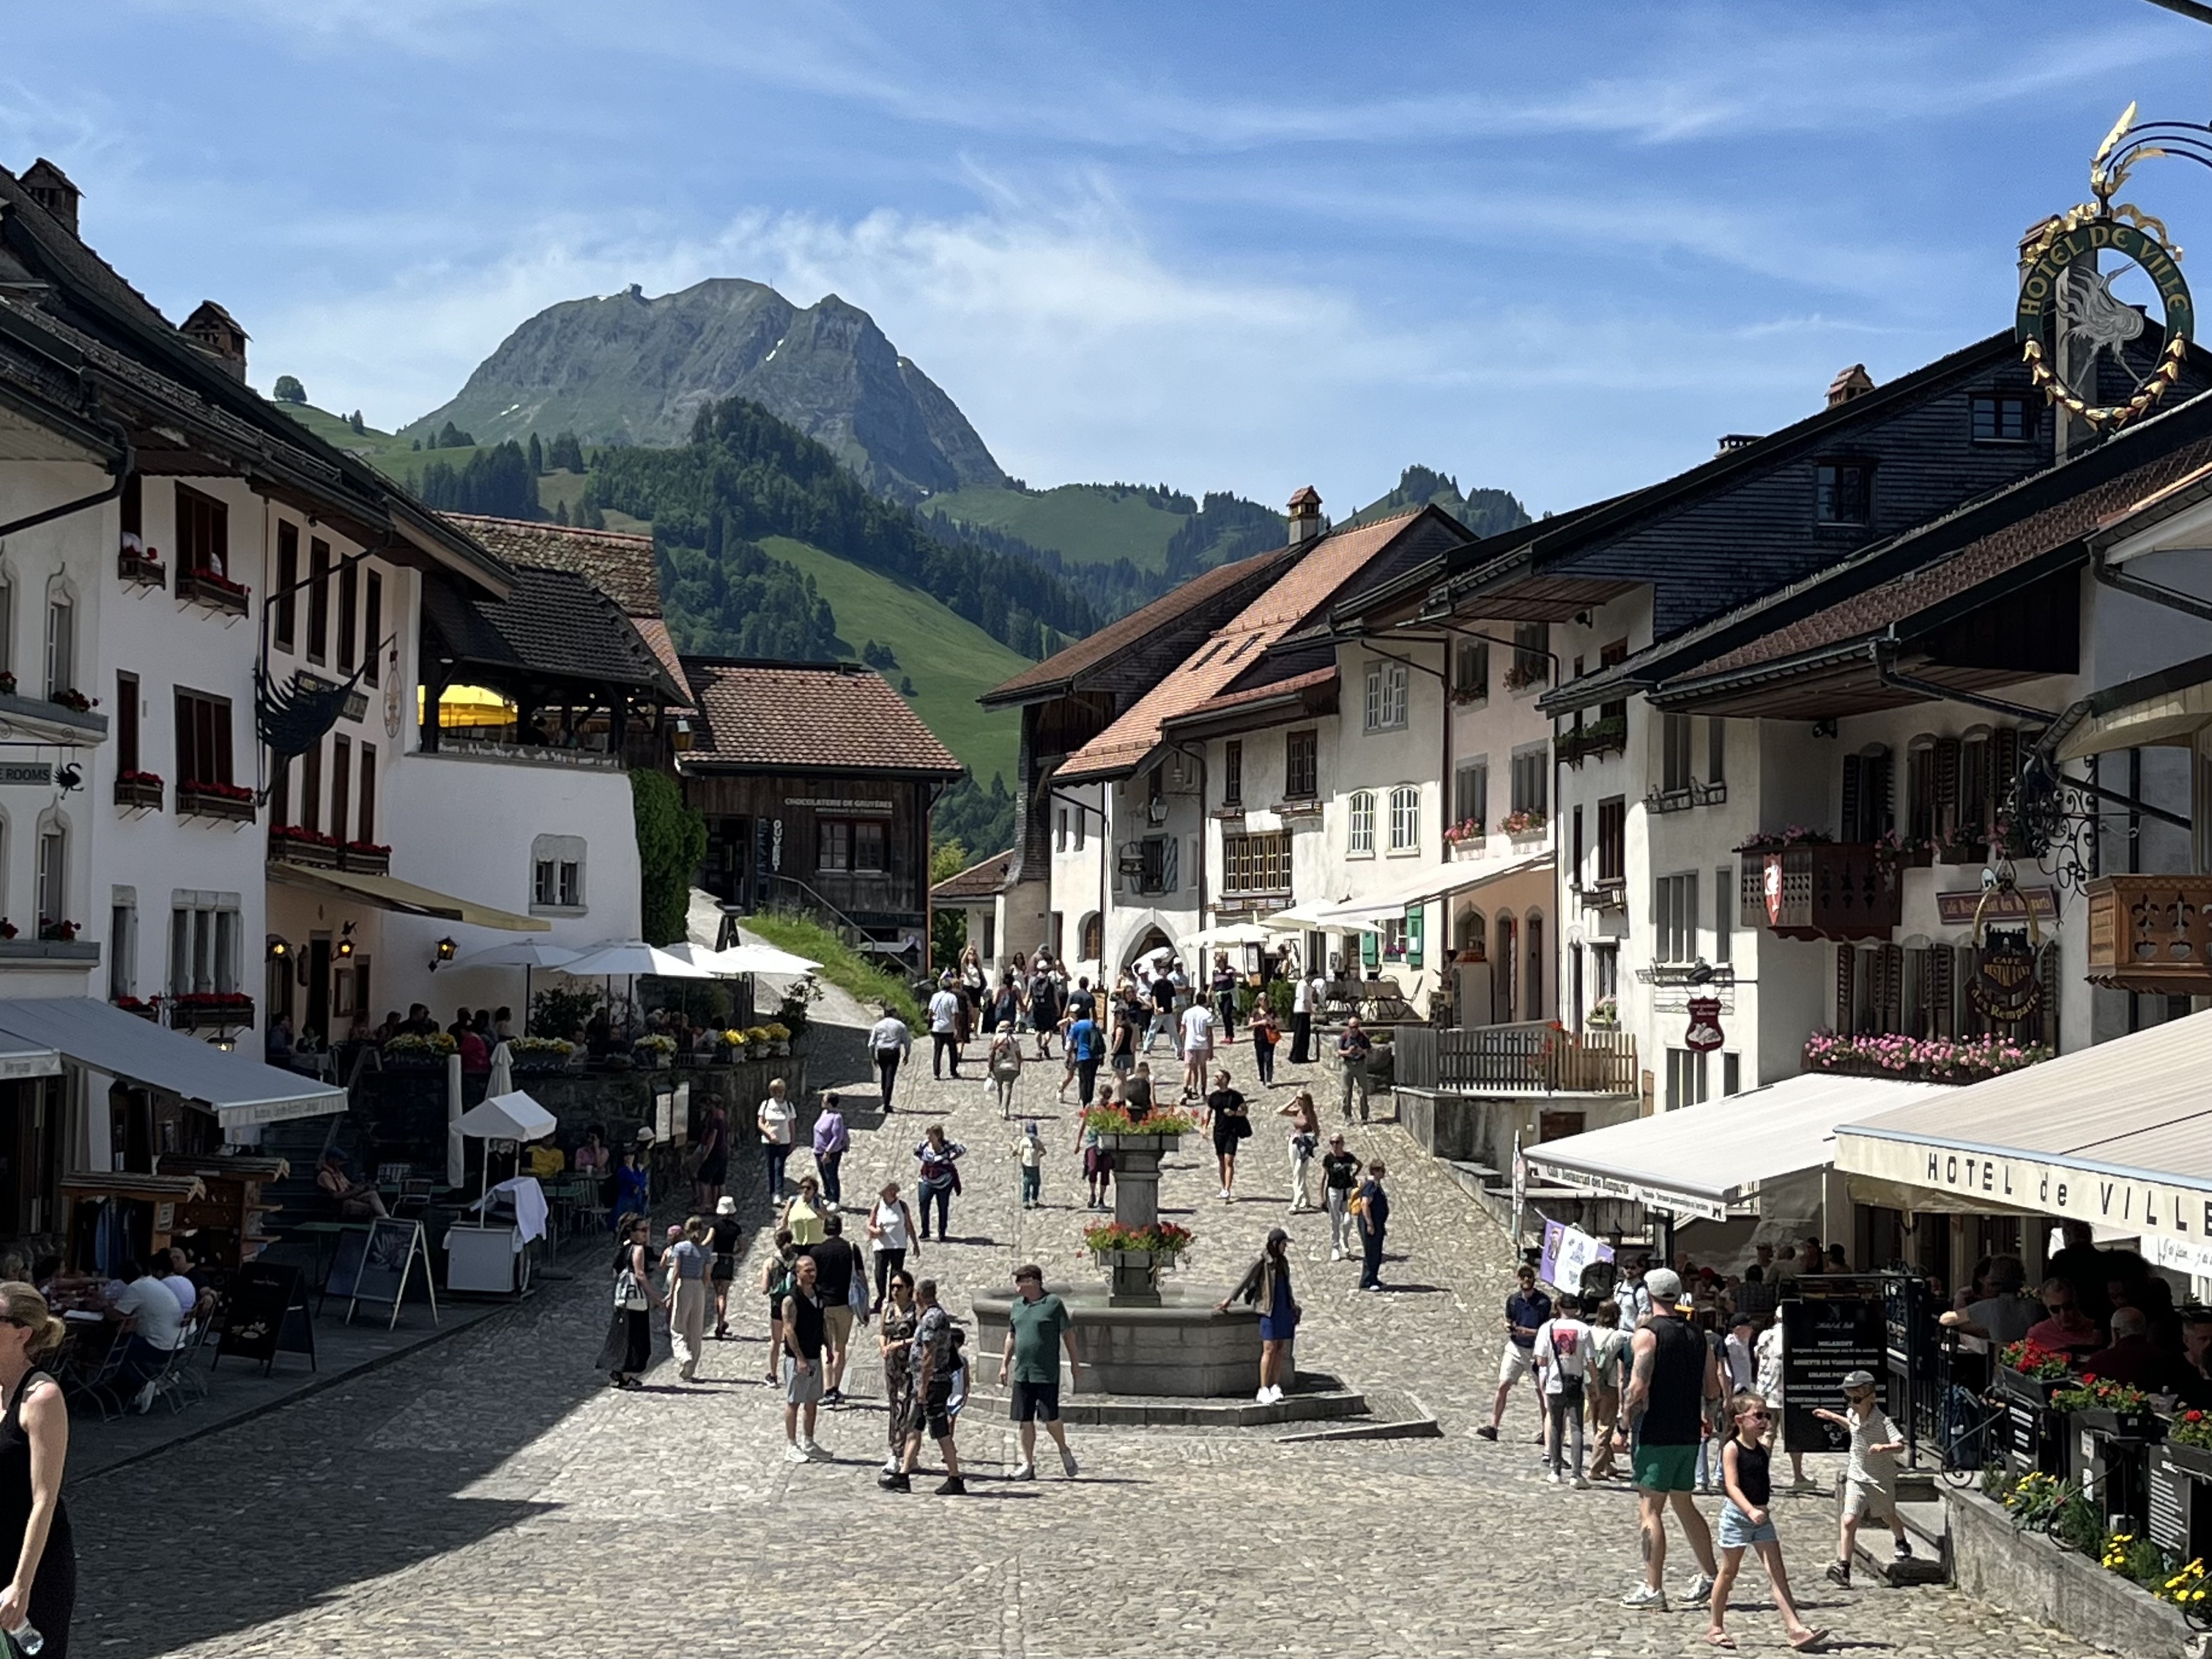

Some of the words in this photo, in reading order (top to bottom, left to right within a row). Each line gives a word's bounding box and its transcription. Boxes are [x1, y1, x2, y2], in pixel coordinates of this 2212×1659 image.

[2089, 226, 2135, 248] DE
[2139, 239, 2189, 313] VILLE
[6, 768, 50, 782] ROOMS
[1991, 991, 2041, 1020] Remparts
[1928, 1153, 2012, 1195] HOTEL
[2040, 1173, 2068, 1206] de
[2101, 1181, 2212, 1236] VILLE
